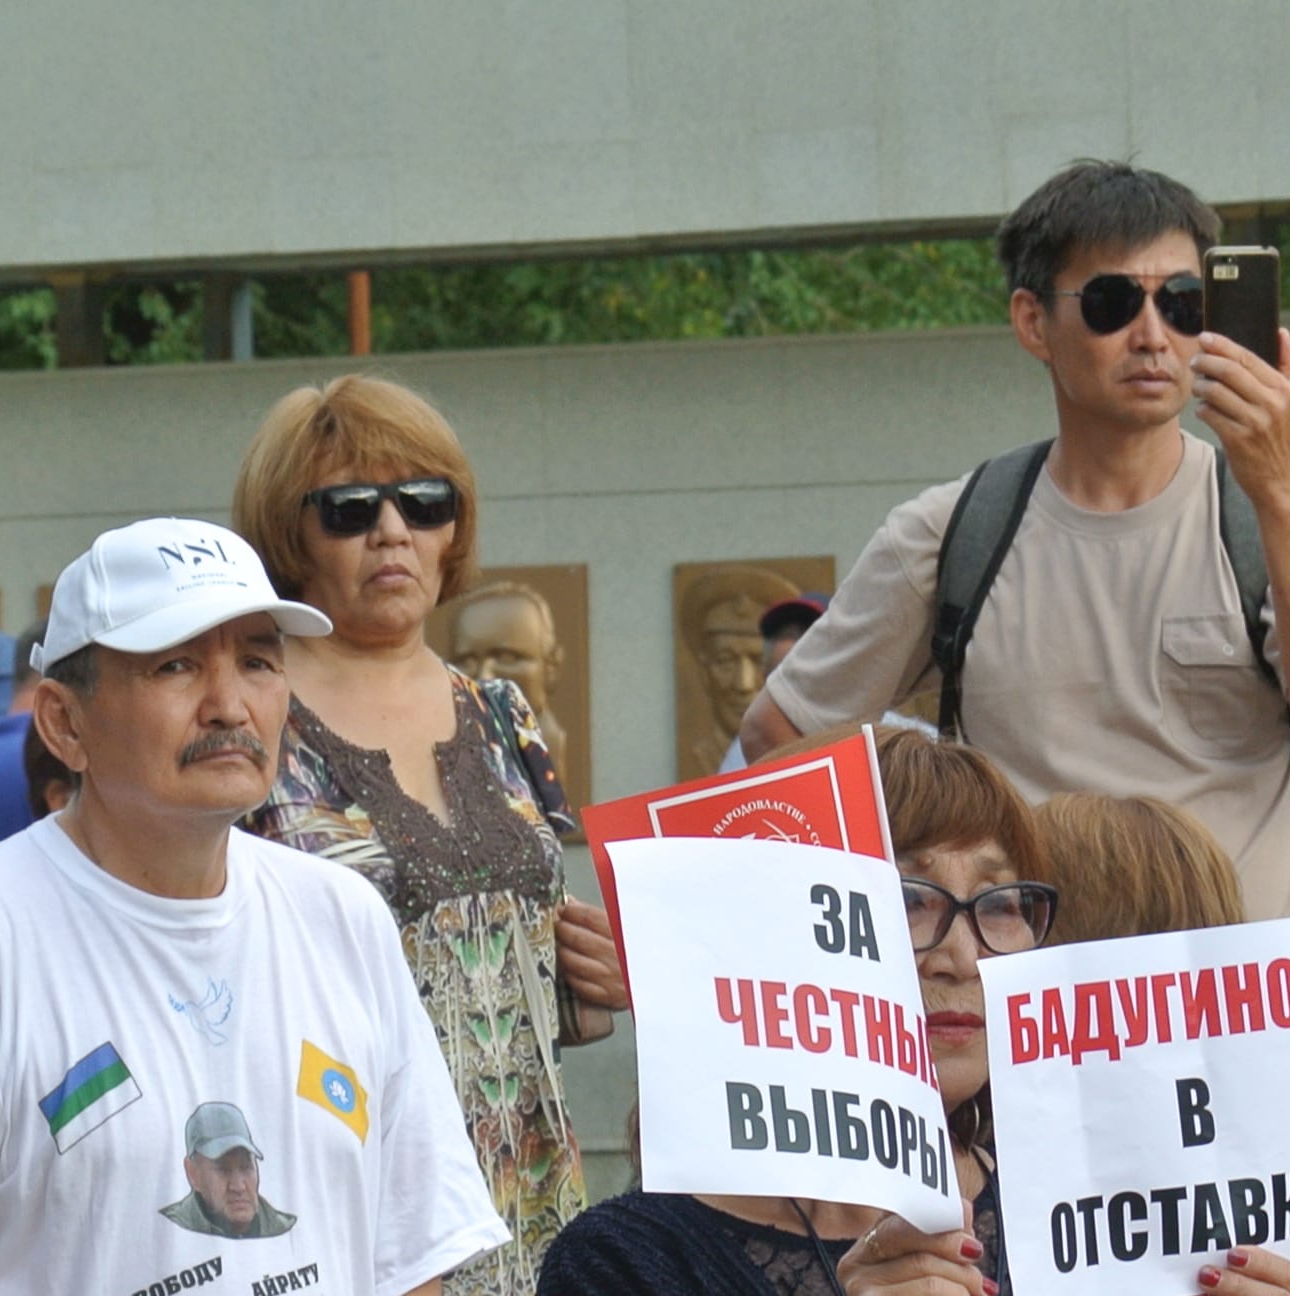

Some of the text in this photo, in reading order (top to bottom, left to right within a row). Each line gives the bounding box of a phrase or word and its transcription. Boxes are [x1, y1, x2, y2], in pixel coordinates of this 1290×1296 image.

[712, 799, 806, 836] НАРОДОВЛАСТИЕ
[810, 883, 880, 962] ЗА
[725, 1080, 949, 1197] ВЫБОРЫ
[1175, 1077, 1216, 1148] В
